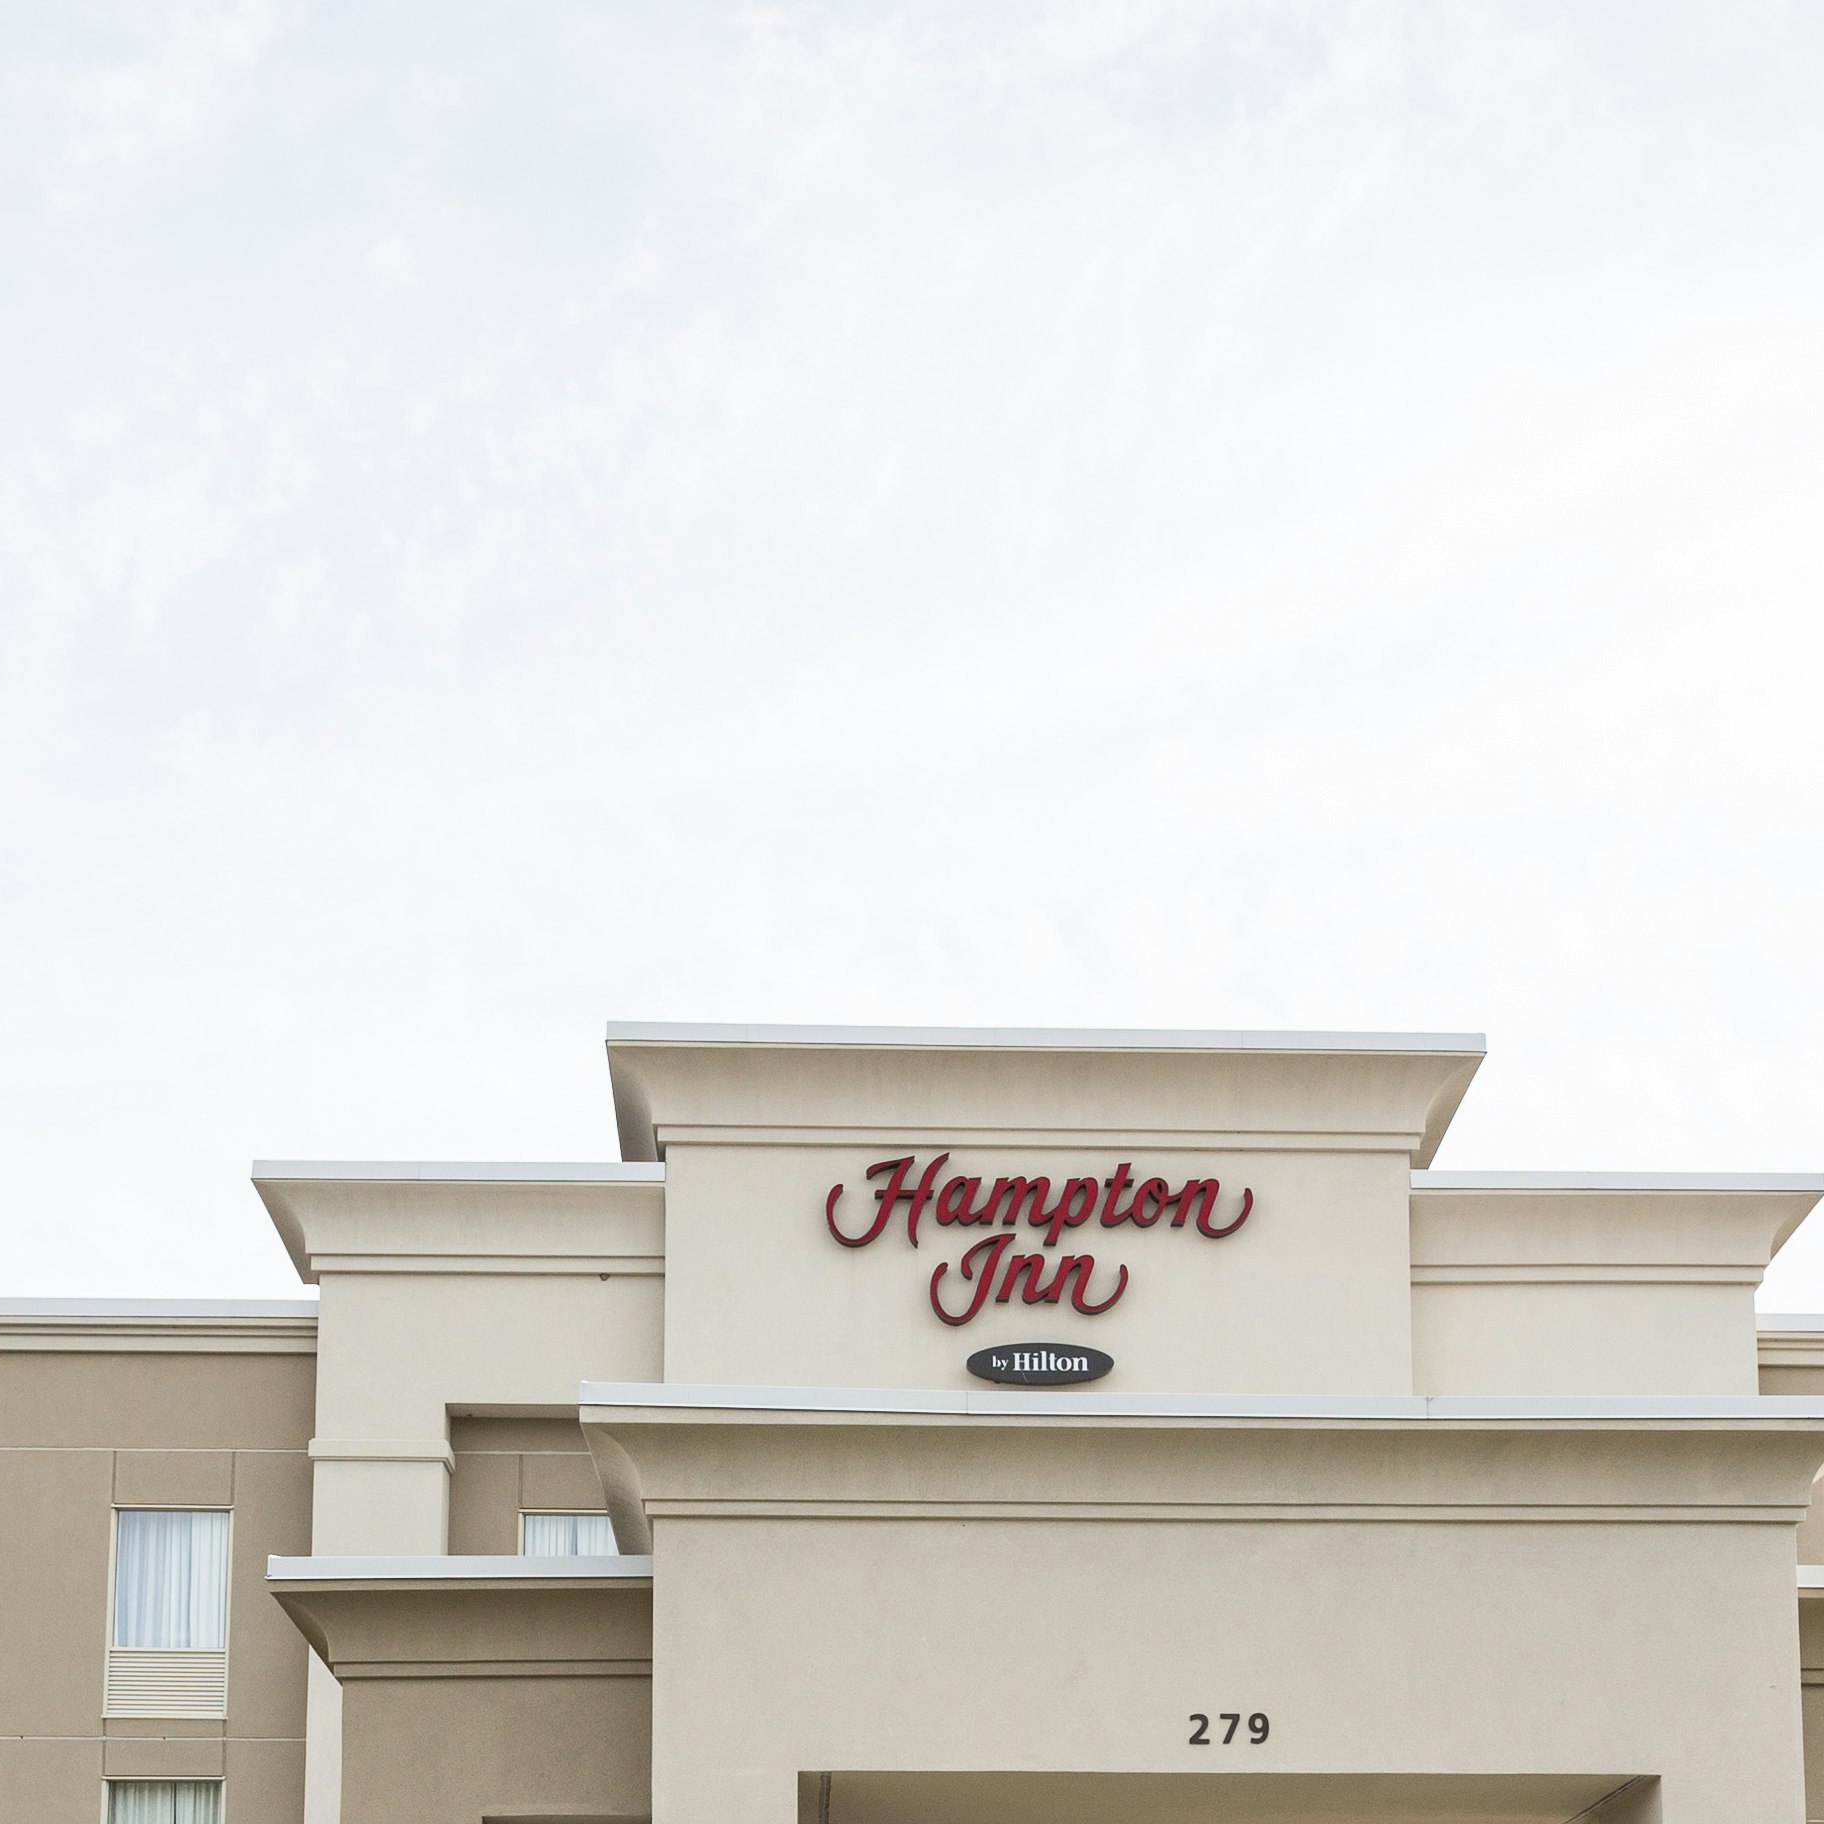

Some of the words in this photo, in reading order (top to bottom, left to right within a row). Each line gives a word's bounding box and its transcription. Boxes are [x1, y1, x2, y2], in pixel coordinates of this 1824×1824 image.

[826, 1152, 1254, 1248] Hampton
[929, 1233, 1129, 1326] Inn
[992, 1355, 1009, 1370] by
[1012, 1350, 1089, 1371] Hilton
[1188, 1712, 1270, 1745] 279
